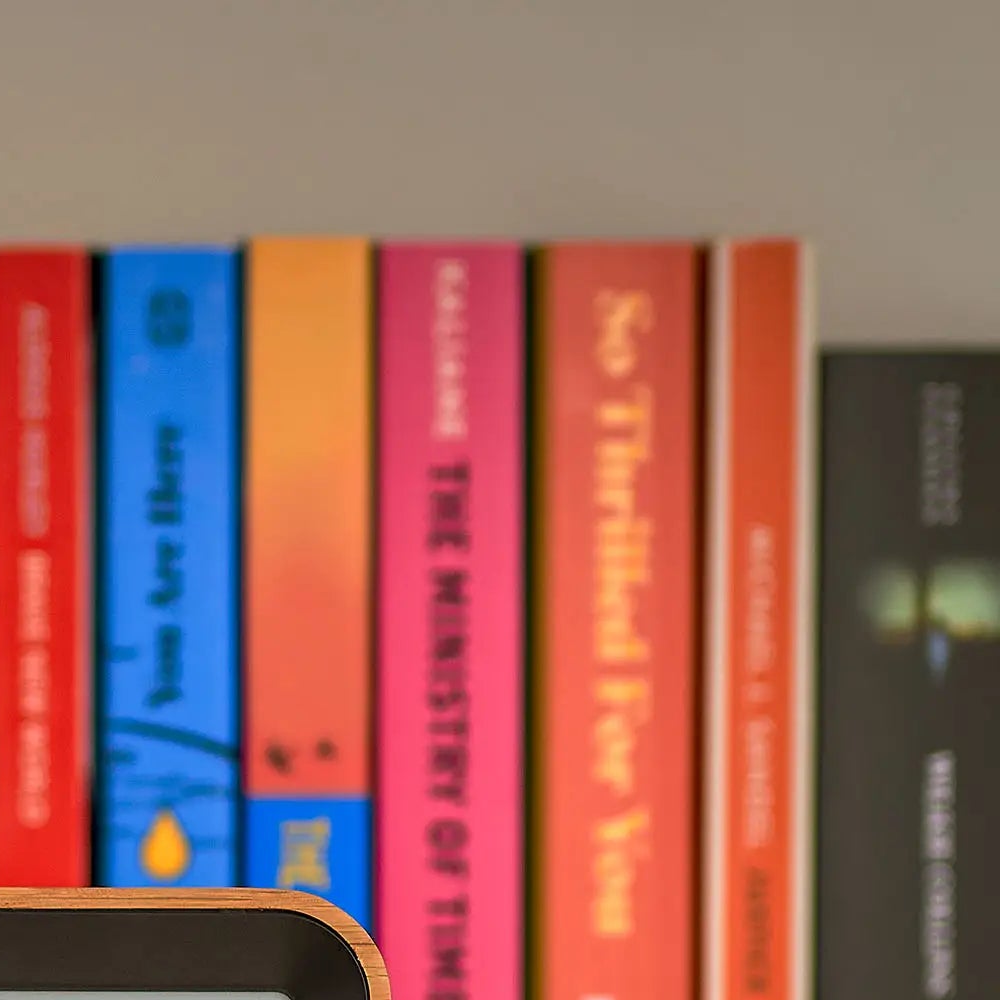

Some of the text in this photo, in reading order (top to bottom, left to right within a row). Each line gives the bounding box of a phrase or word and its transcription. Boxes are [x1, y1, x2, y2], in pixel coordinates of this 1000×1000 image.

[432, 258, 471, 440] KALIANE
[426, 460, 472, 551] THE
[428, 569, 471, 808] MINISTRY
[588, 288, 658, 940] So Thrilled For You
[428, 819, 471, 881] OF
